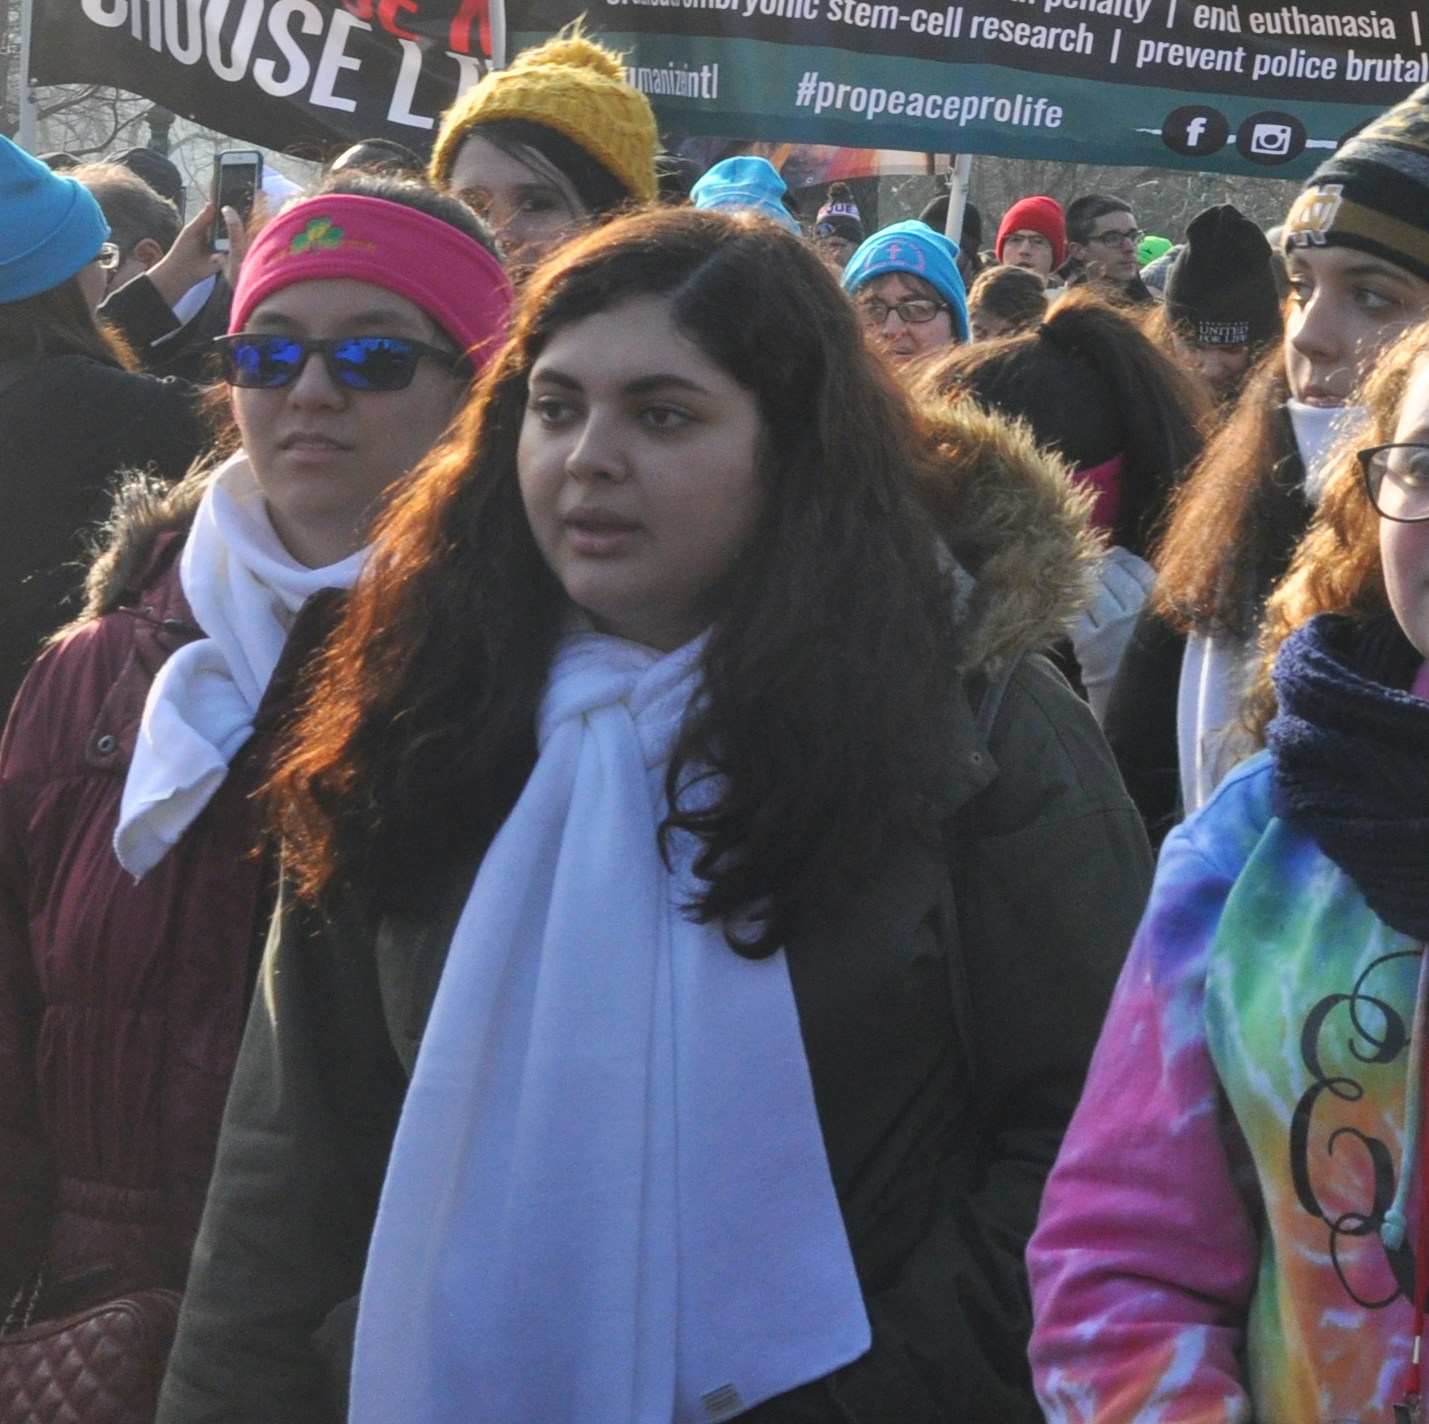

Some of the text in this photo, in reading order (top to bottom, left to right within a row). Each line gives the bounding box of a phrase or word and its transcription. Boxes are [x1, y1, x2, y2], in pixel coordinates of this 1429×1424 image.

[969, 13, 1094, 54] research
[1136, 36, 1246, 73] prevent
[1252, 49, 1337, 81] police
[1193, 3, 1240, 33] end
[1248, 6, 1396, 40] euthanasia
[796, 70, 1063, 128] #propeaceprolife
